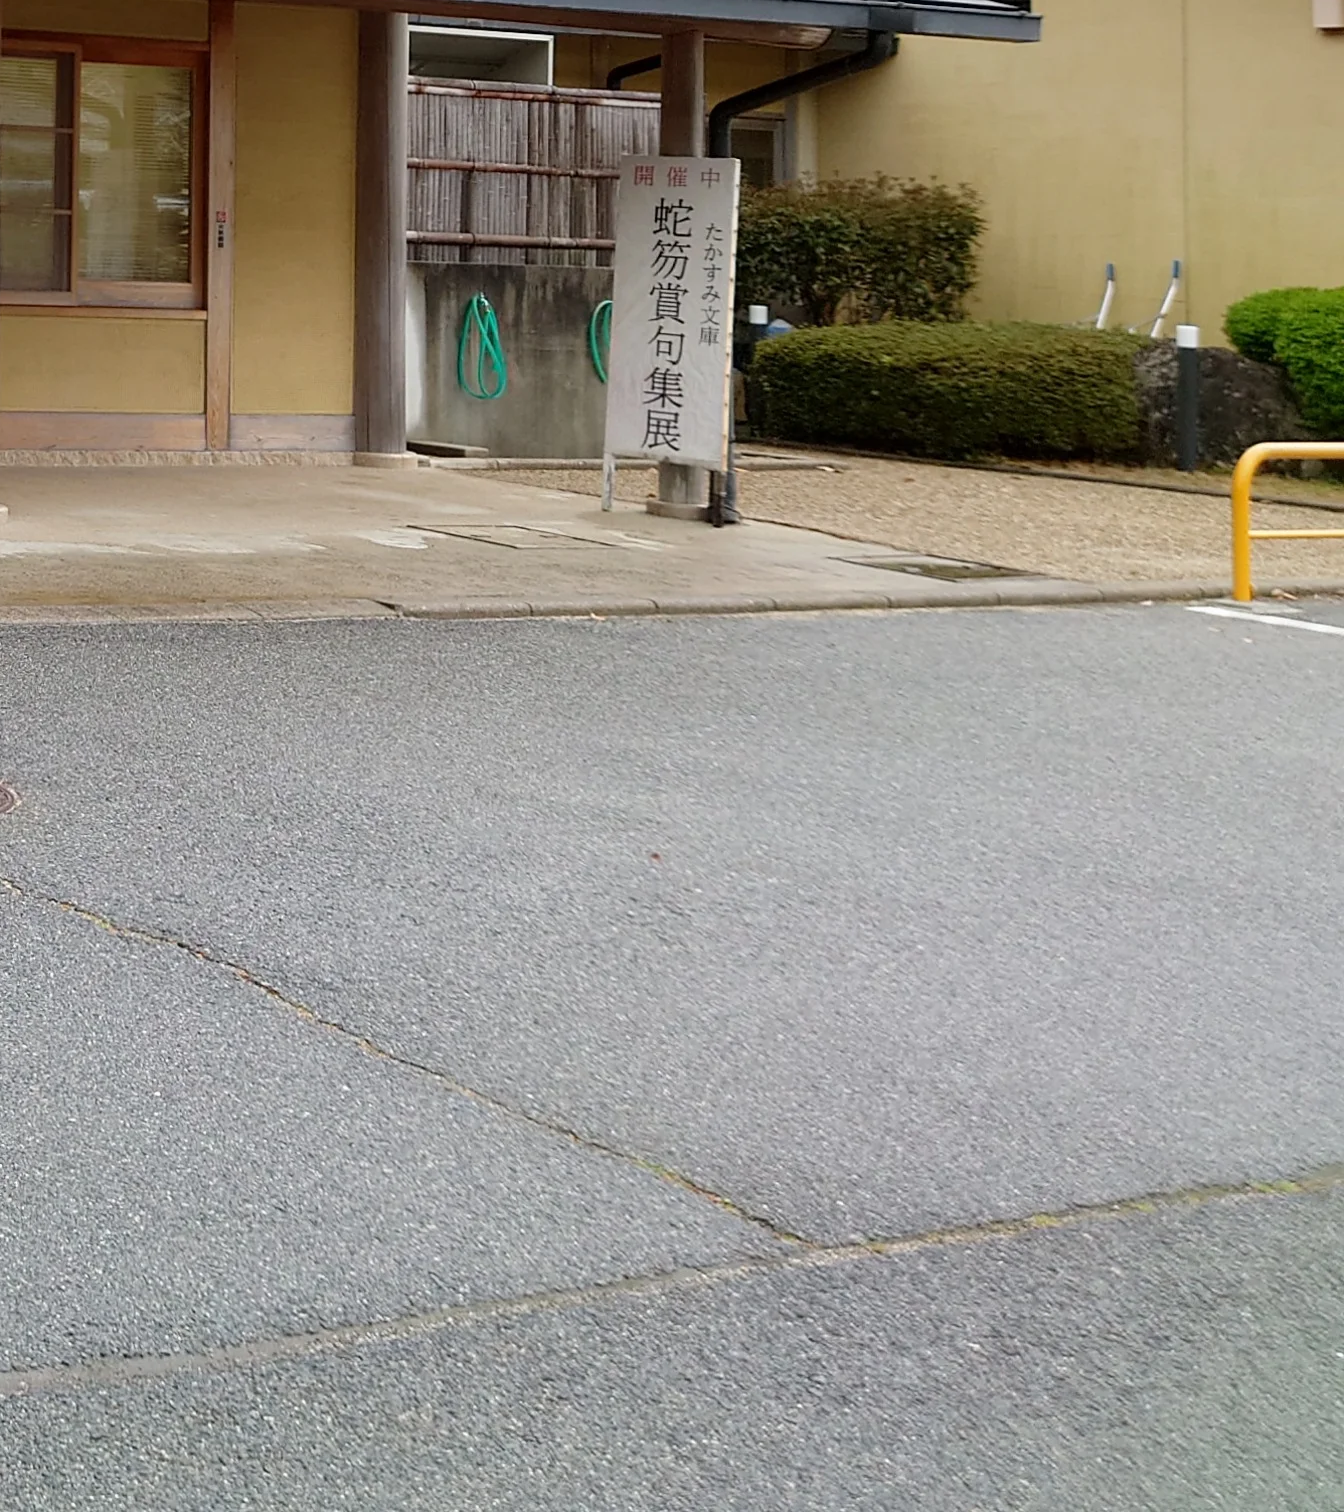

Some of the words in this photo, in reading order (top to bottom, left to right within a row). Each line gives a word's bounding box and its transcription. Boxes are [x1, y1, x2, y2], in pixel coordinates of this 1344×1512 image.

[634, 165, 722, 189] 開催中
[640, 196, 695, 452] 蛇笏賞句集展
[698, 222, 724, 347] たかすみ文庫
